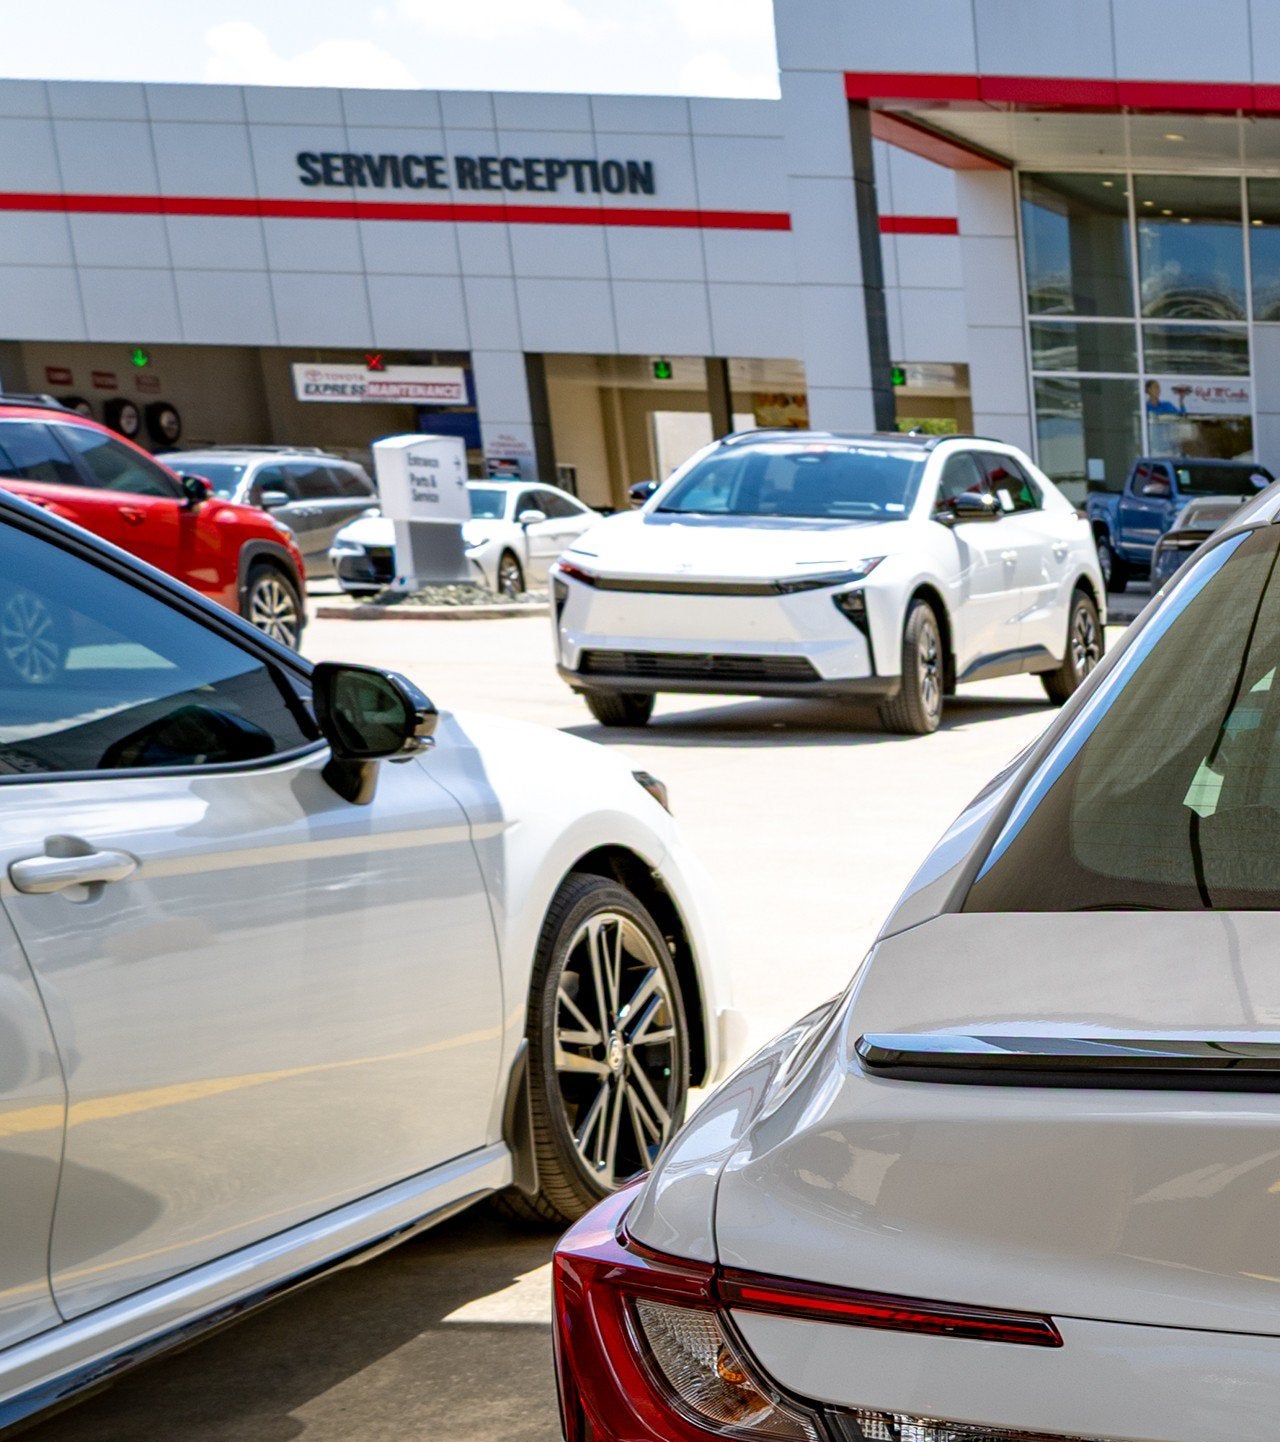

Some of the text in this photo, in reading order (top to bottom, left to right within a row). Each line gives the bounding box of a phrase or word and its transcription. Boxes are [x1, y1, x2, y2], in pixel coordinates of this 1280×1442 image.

[296, 152, 656, 195] SERVICE RECEPTION
[304, 383, 367, 395] EXPRESS
